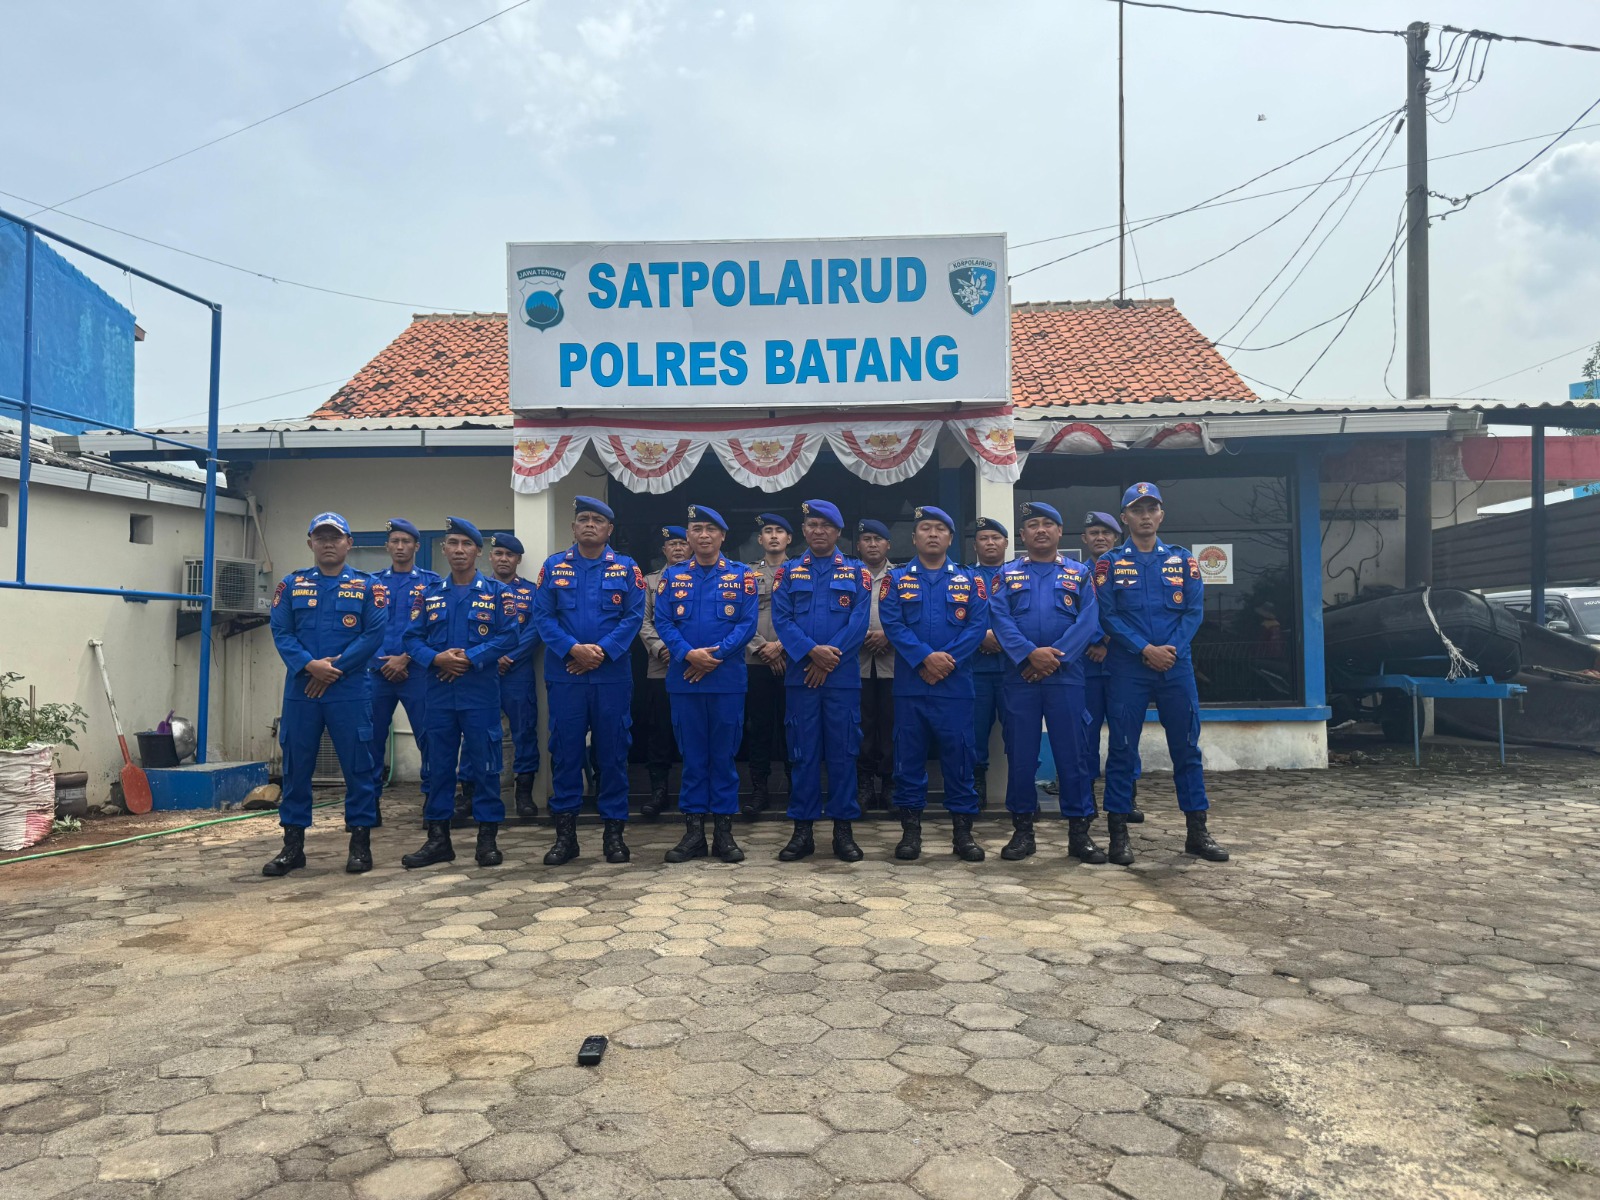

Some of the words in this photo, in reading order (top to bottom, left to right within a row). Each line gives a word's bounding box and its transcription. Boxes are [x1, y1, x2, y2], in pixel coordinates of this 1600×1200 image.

[952, 259, 993, 269] KORPOLAIRUD
[519, 269, 537, 279] JAWA
[537, 269, 565, 279] TENGAH
[588, 256, 927, 309] SATPOLAIRUD
[560, 340, 748, 388] POLRES
[765, 334, 959, 385] BATANG
[1057, 574, 1082, 583] POLRI
[338, 591, 364, 599] POLRI
[472, 601, 496, 611] POLRI
